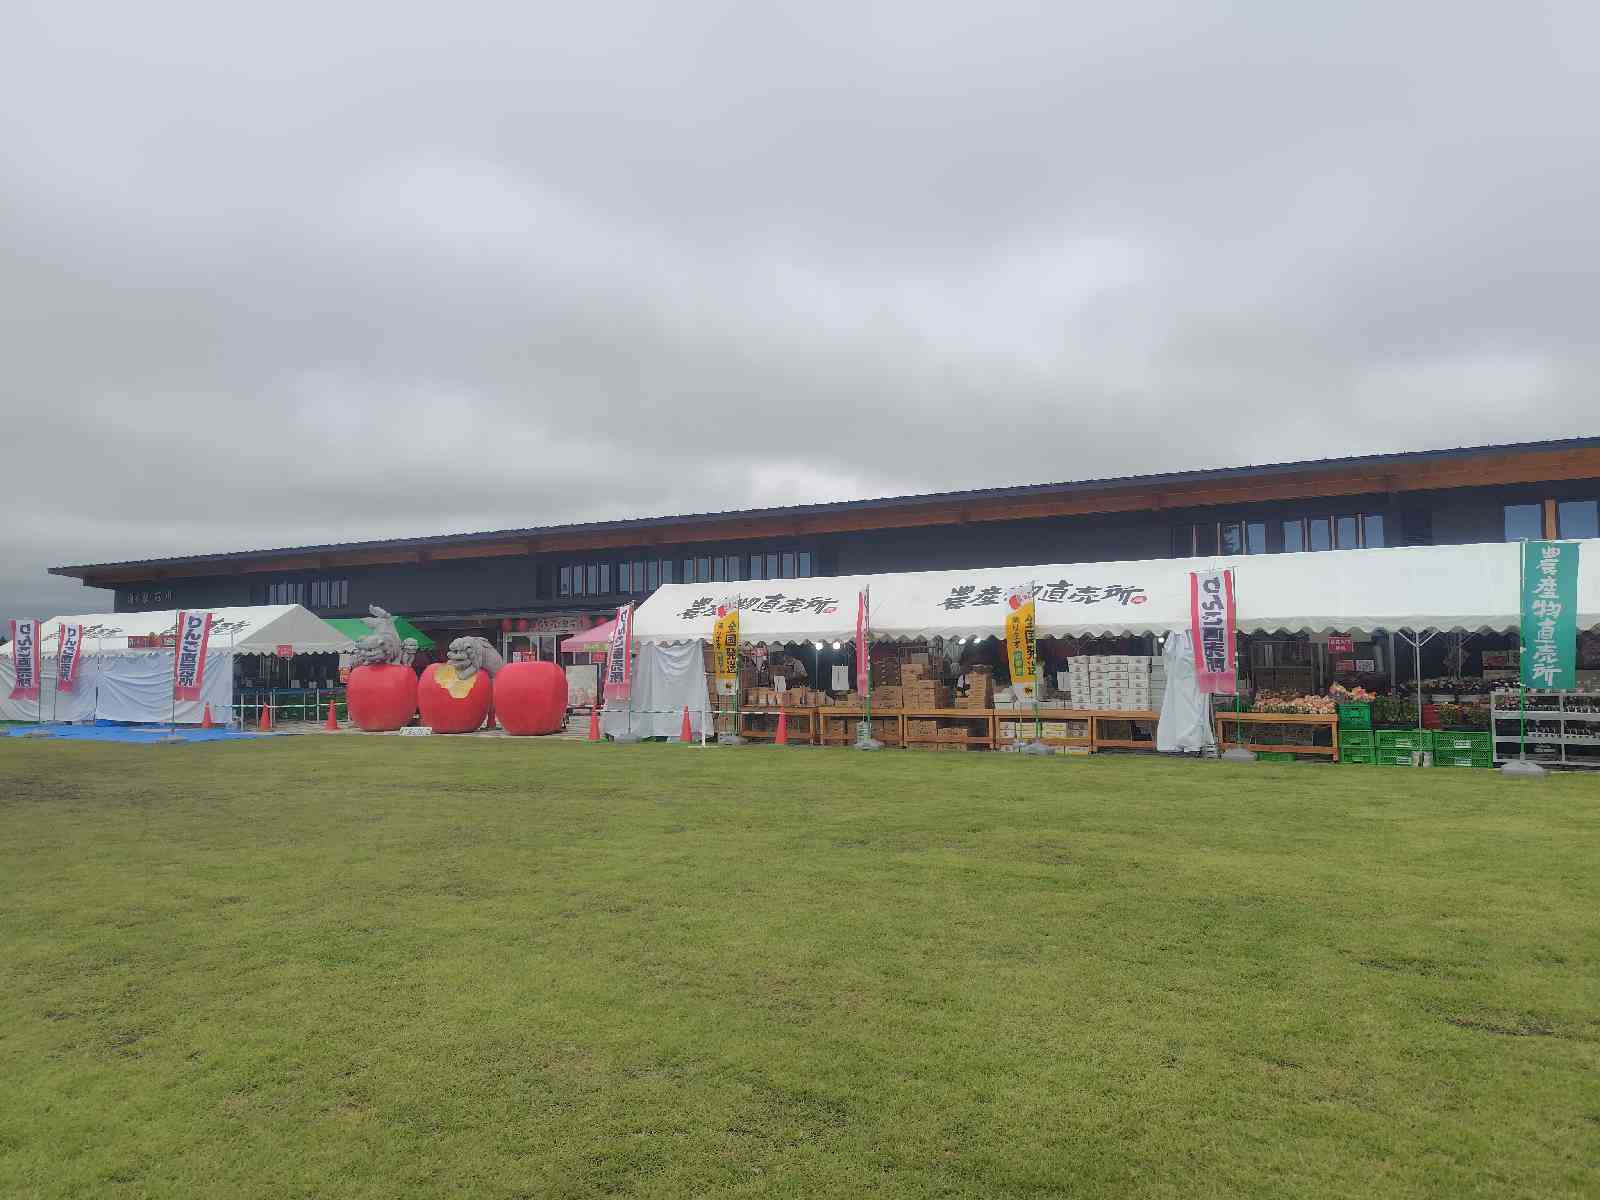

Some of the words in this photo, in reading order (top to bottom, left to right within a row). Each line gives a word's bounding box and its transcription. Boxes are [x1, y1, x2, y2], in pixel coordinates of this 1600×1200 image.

[936, 580, 1145, 610] 農産直売所
[1532, 546, 1562, 687] 農産物直売所
